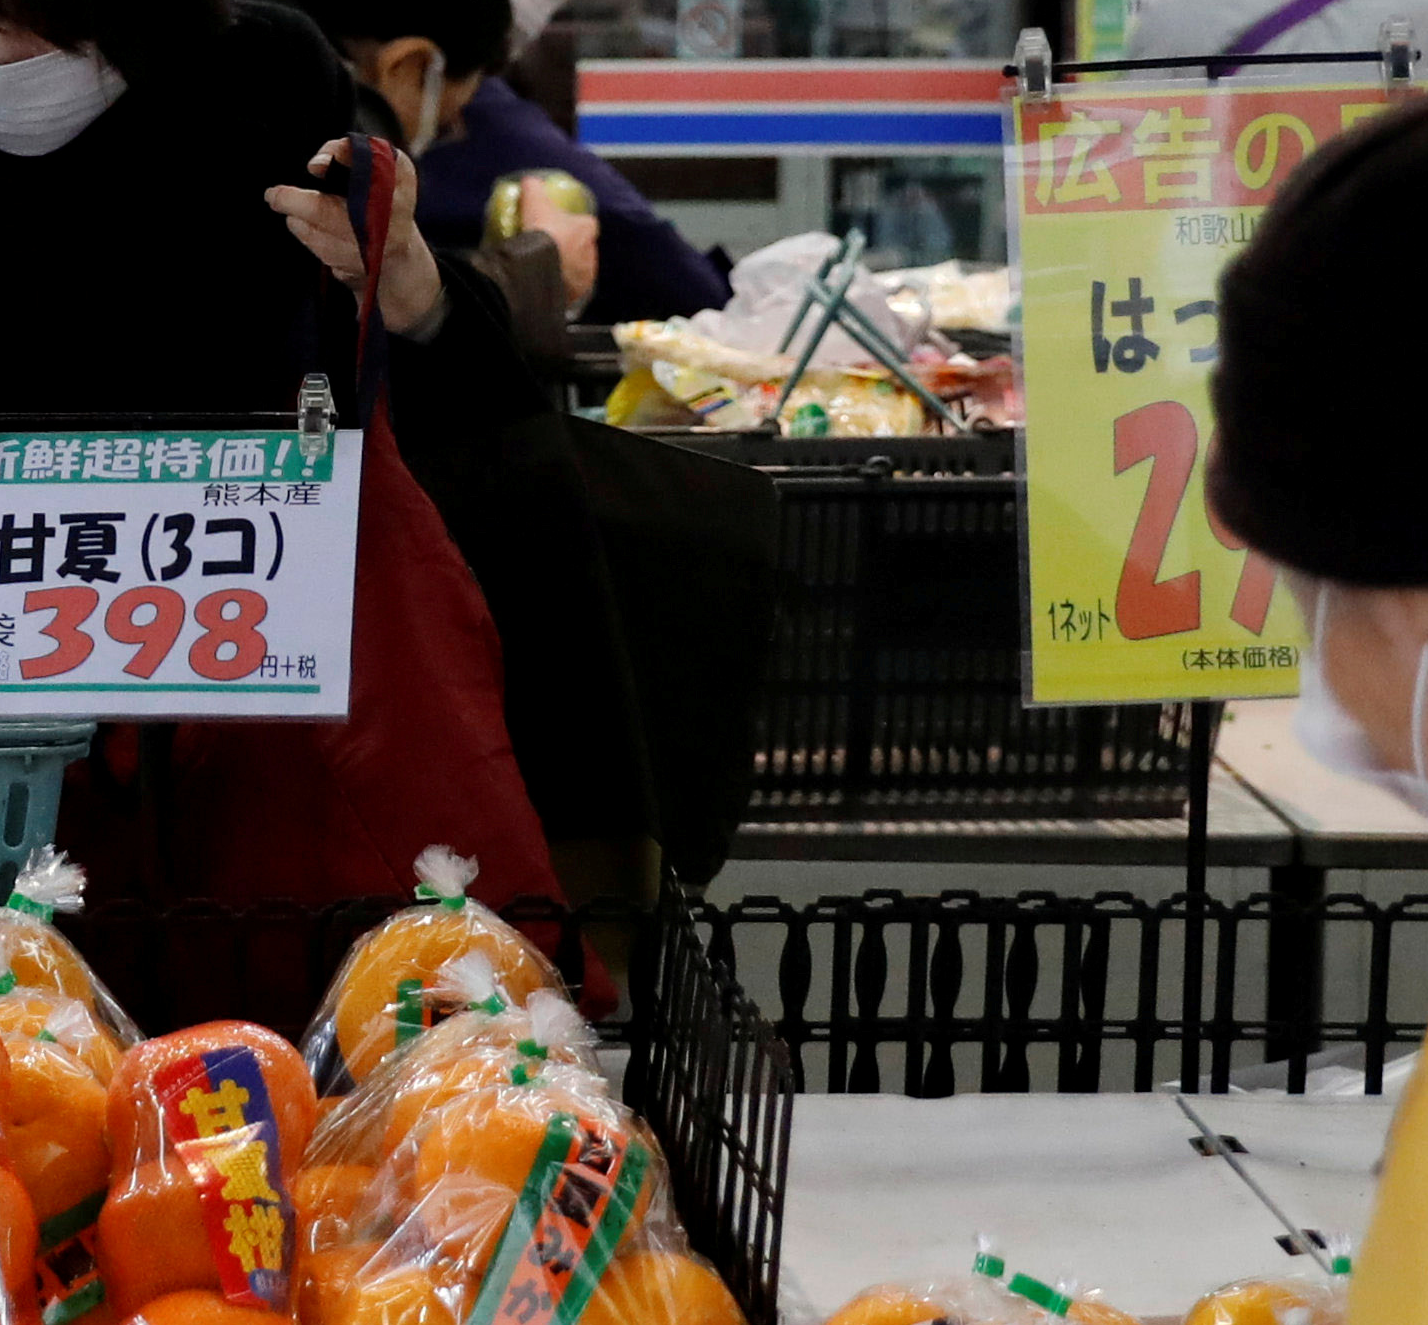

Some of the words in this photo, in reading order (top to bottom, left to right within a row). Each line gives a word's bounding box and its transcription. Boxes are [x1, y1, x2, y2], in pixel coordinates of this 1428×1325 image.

[1035, 101, 1342, 208] 広告の
[1175, 215, 1259, 247] 和歌山
[202, 482, 321, 506] 熊本産
[19, 586, 268, 681] 398
[1181, 645, 1300, 671] (本体価格)
[178, 1078, 285, 1275] 甘夏柑
